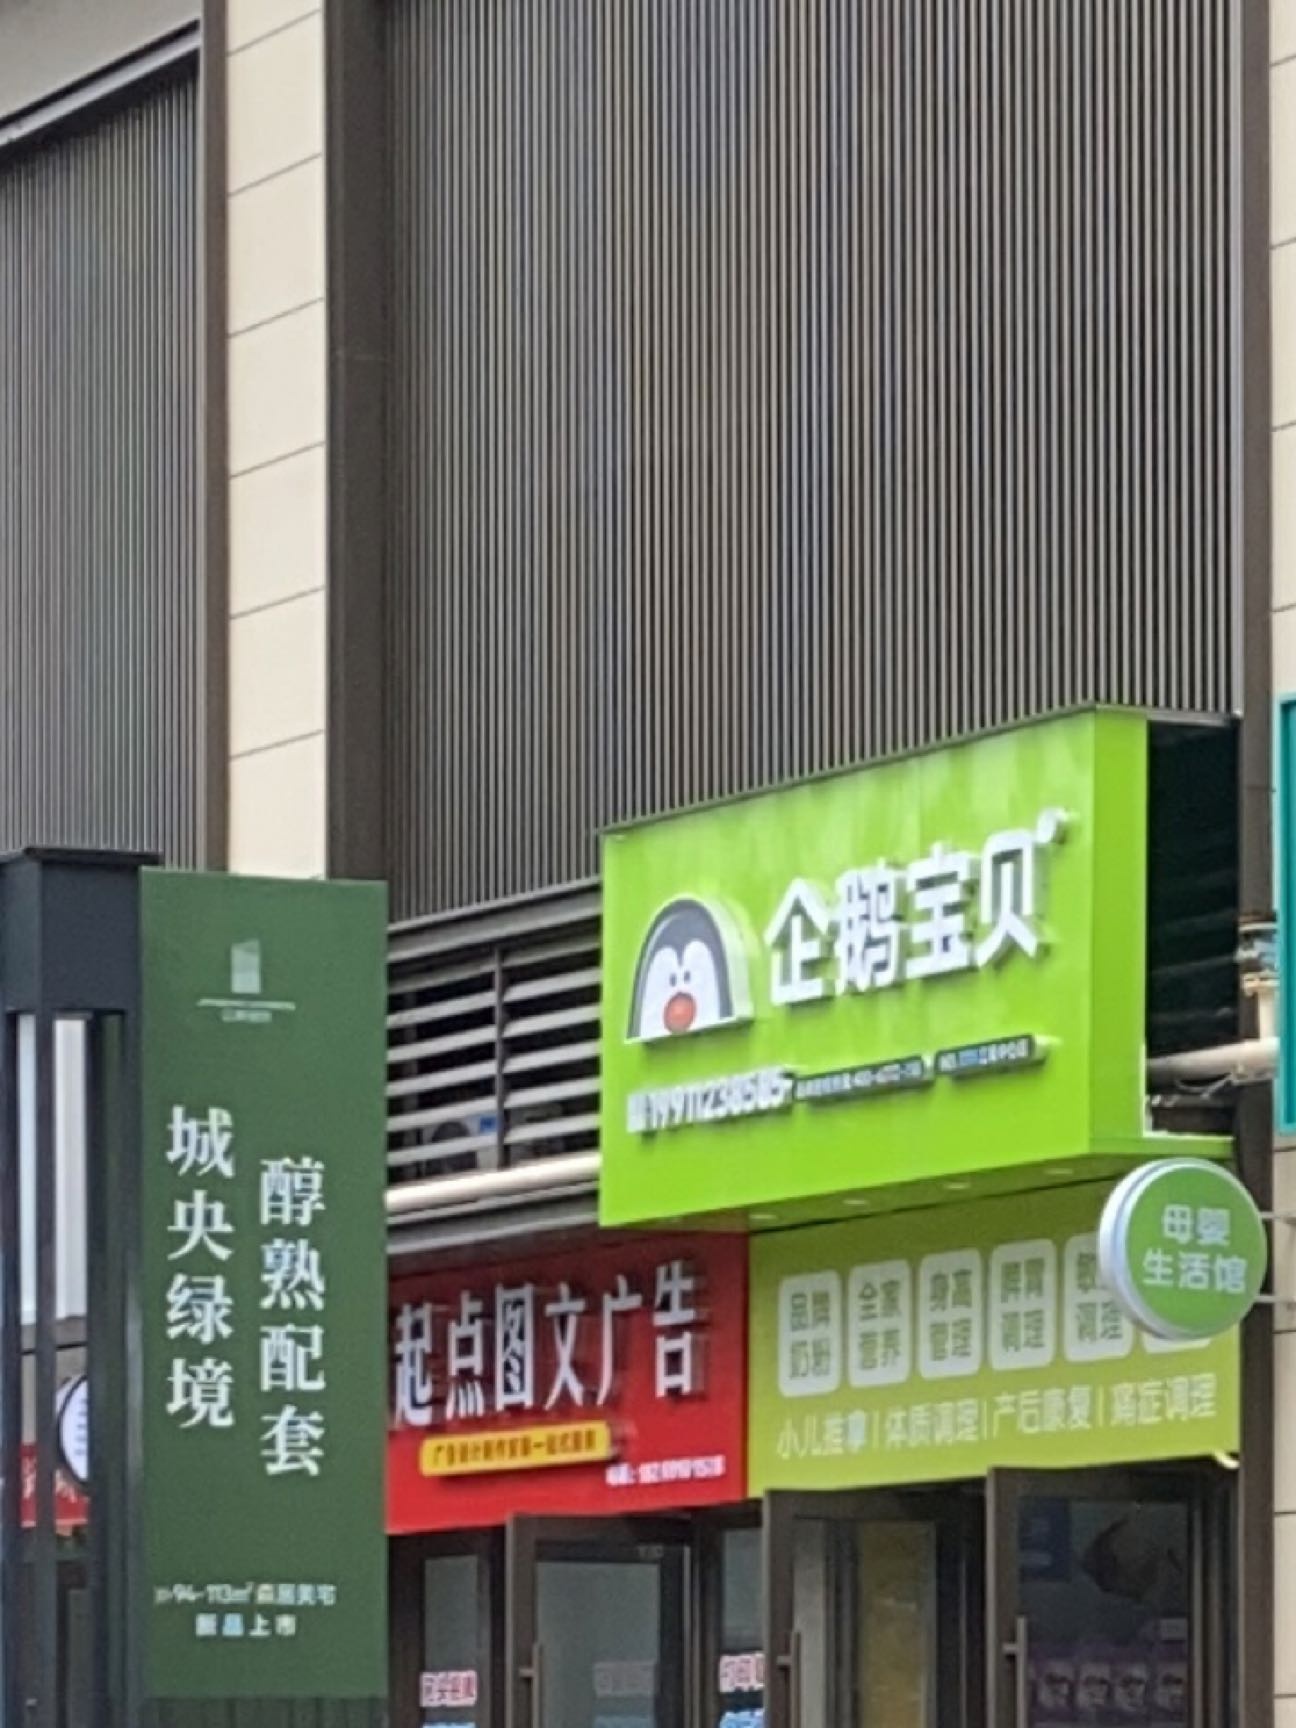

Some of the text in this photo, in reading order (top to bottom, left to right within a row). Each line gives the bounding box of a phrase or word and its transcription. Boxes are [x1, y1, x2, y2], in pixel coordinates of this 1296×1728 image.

[763, 829, 1038, 1007] 企鹅宝贝
[166, 1104, 235, 1429] 城央绿境
[1142, 1248, 1248, 1294] 生活馆
[1163, 1204, 1231, 1245] 母婴
[259, 1156, 326, 1477] 醇熟配套
[394, 1261, 697, 1429] 起点图文广告
[776, 1408, 868, 1460] 小儿推拿
[884, 1399, 979, 1449] 体质调理
[993, 1387, 1091, 1440] 产后康复
